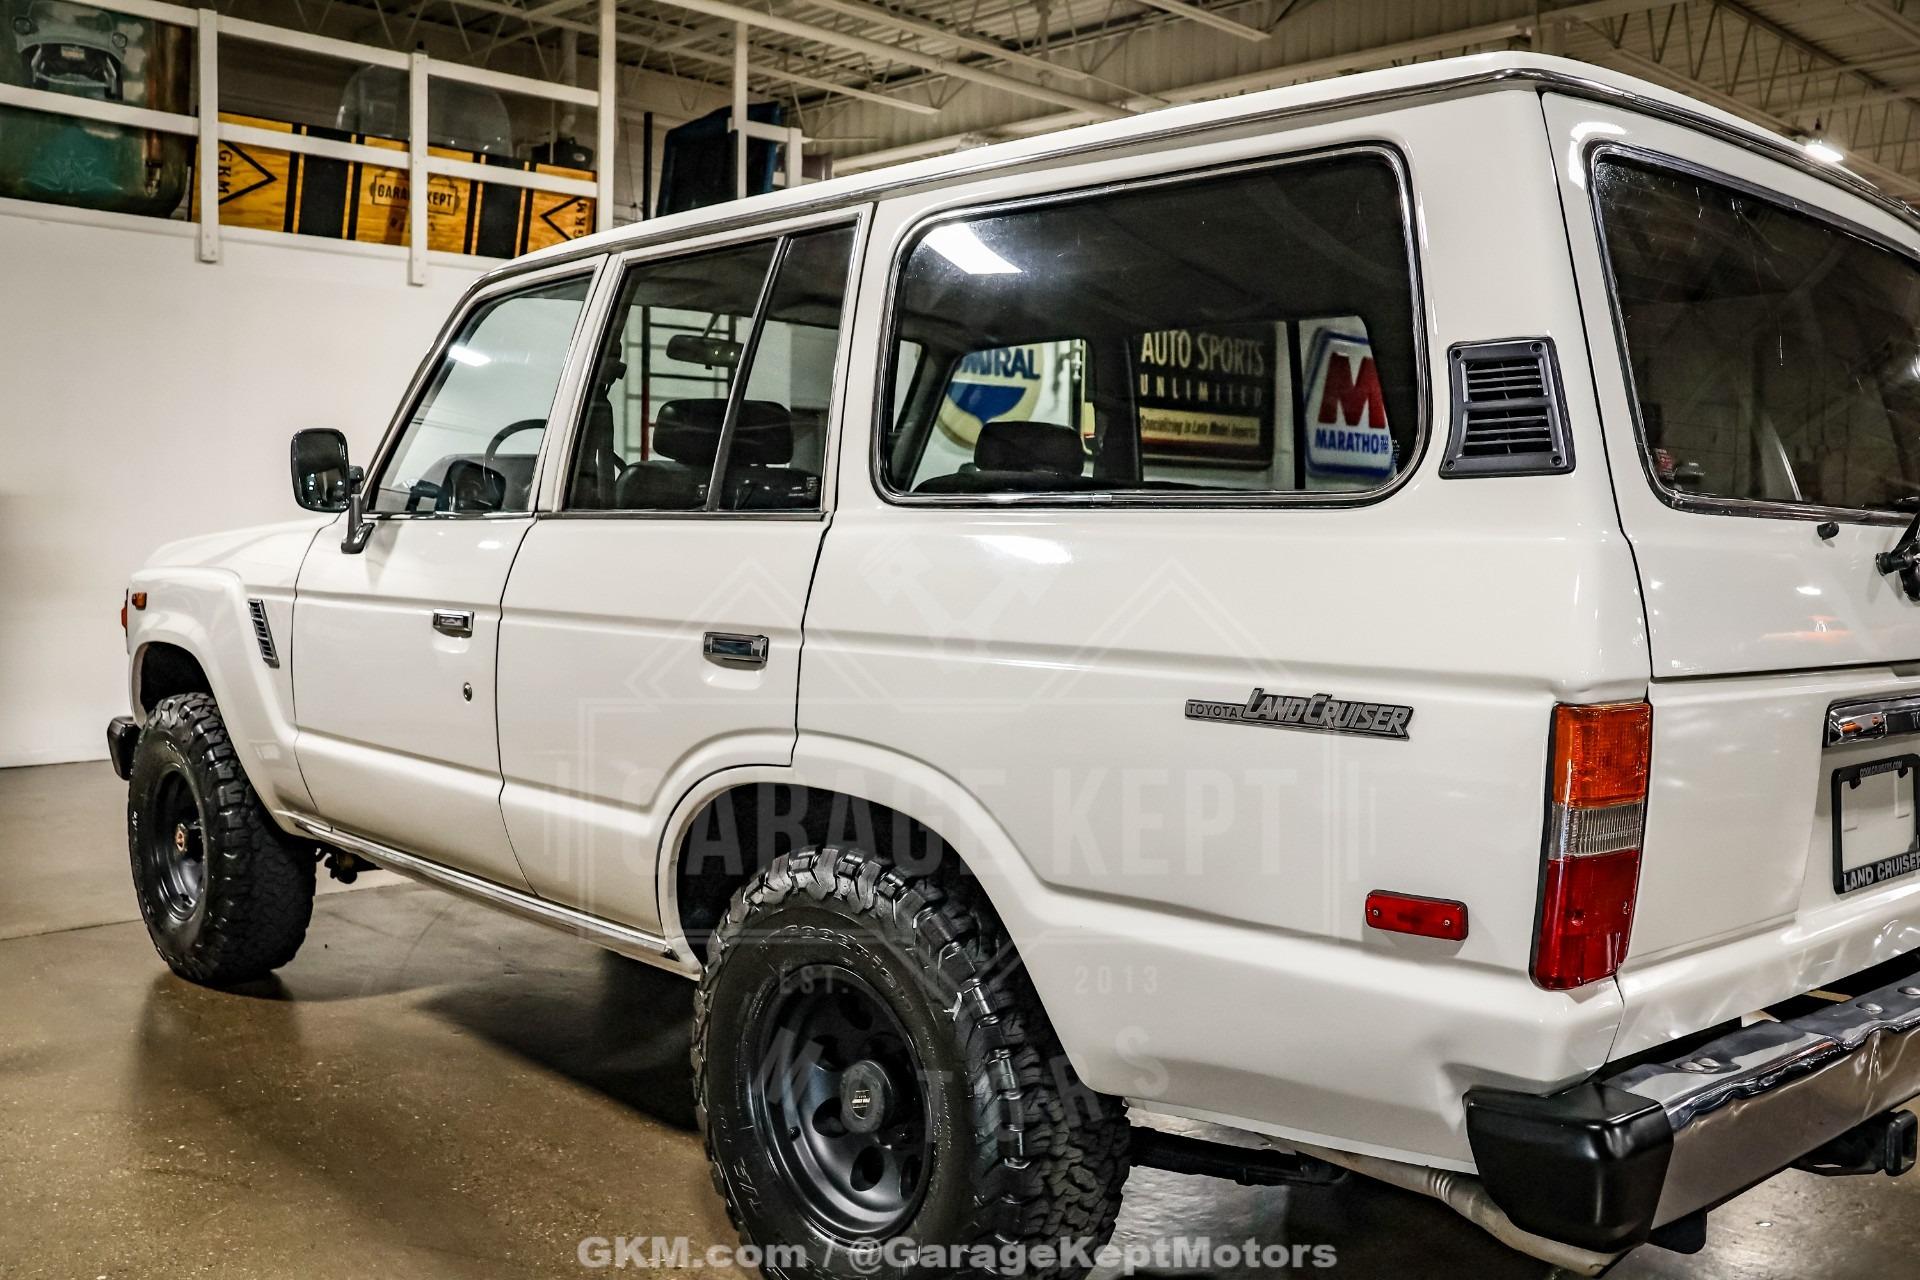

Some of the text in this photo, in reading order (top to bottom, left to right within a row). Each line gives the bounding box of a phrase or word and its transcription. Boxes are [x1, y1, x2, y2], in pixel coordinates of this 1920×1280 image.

[218, 150, 233, 195] GKM
[377, 184, 409, 200] GARA
[961, 347, 1041, 380] MIRAL
[1141, 329, 1264, 377] AUTO SPORTS
[1140, 373, 1262, 407] UNLIMITED
[1318, 352, 1386, 429] M
[1188, 703, 1239, 718] TOYOTA
[1844, 866, 1874, 892] LAND
